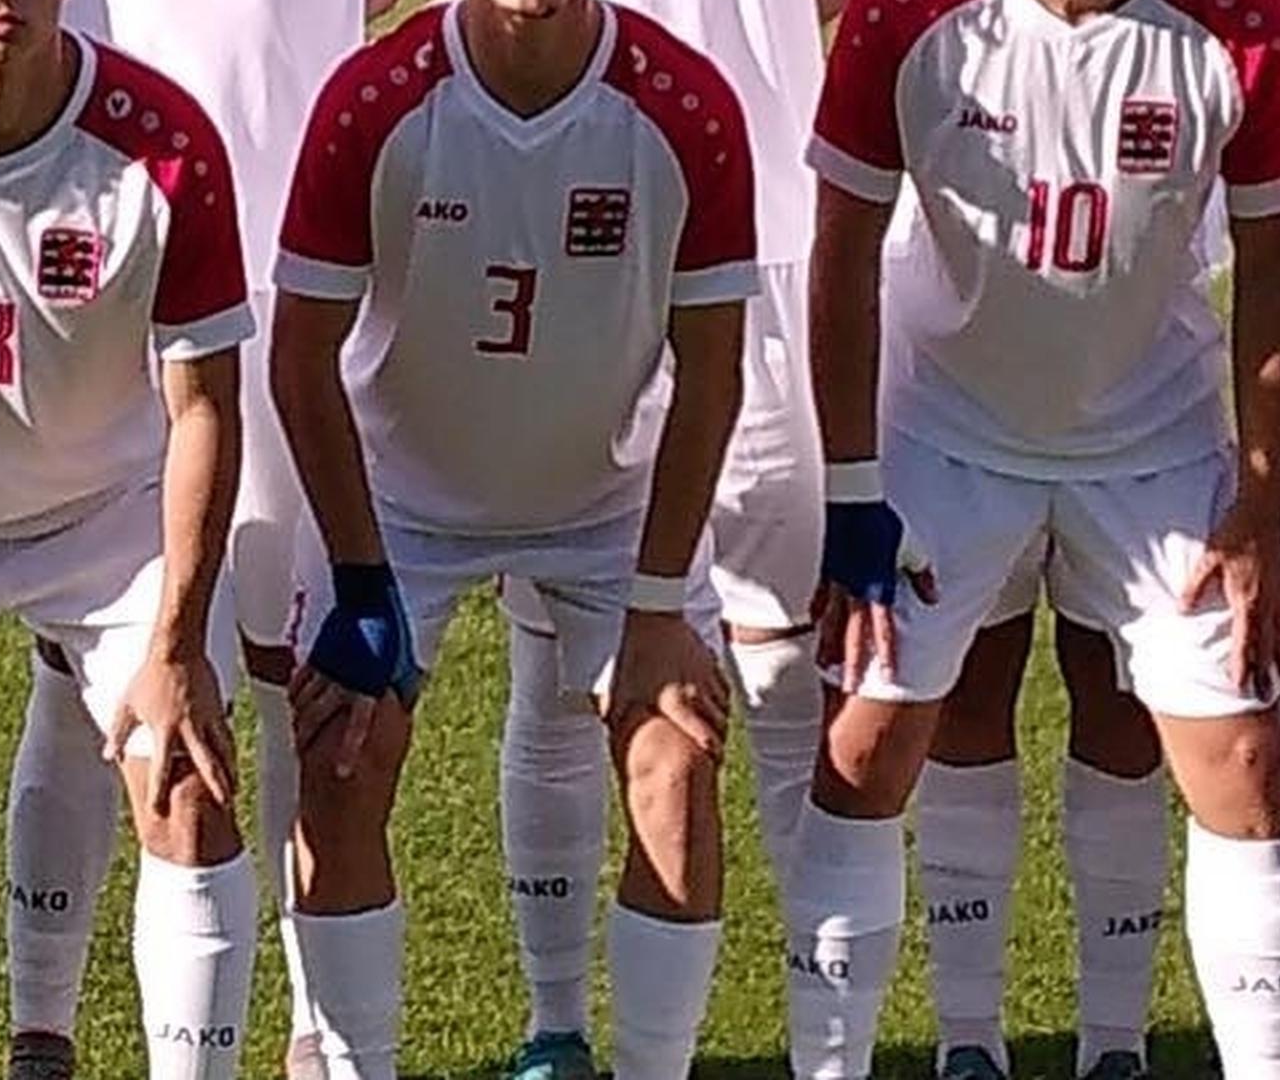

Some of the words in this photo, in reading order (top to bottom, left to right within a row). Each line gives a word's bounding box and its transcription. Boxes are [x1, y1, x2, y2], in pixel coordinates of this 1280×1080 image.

[956, 110, 1017, 133] JAKO
[415, 201, 468, 221] AKO
[1027, 179, 1108, 272] 10
[476, 265, 537, 355] 3
[787, 954, 848, 978] AKO
[155, 1023, 236, 1048] JAKO
